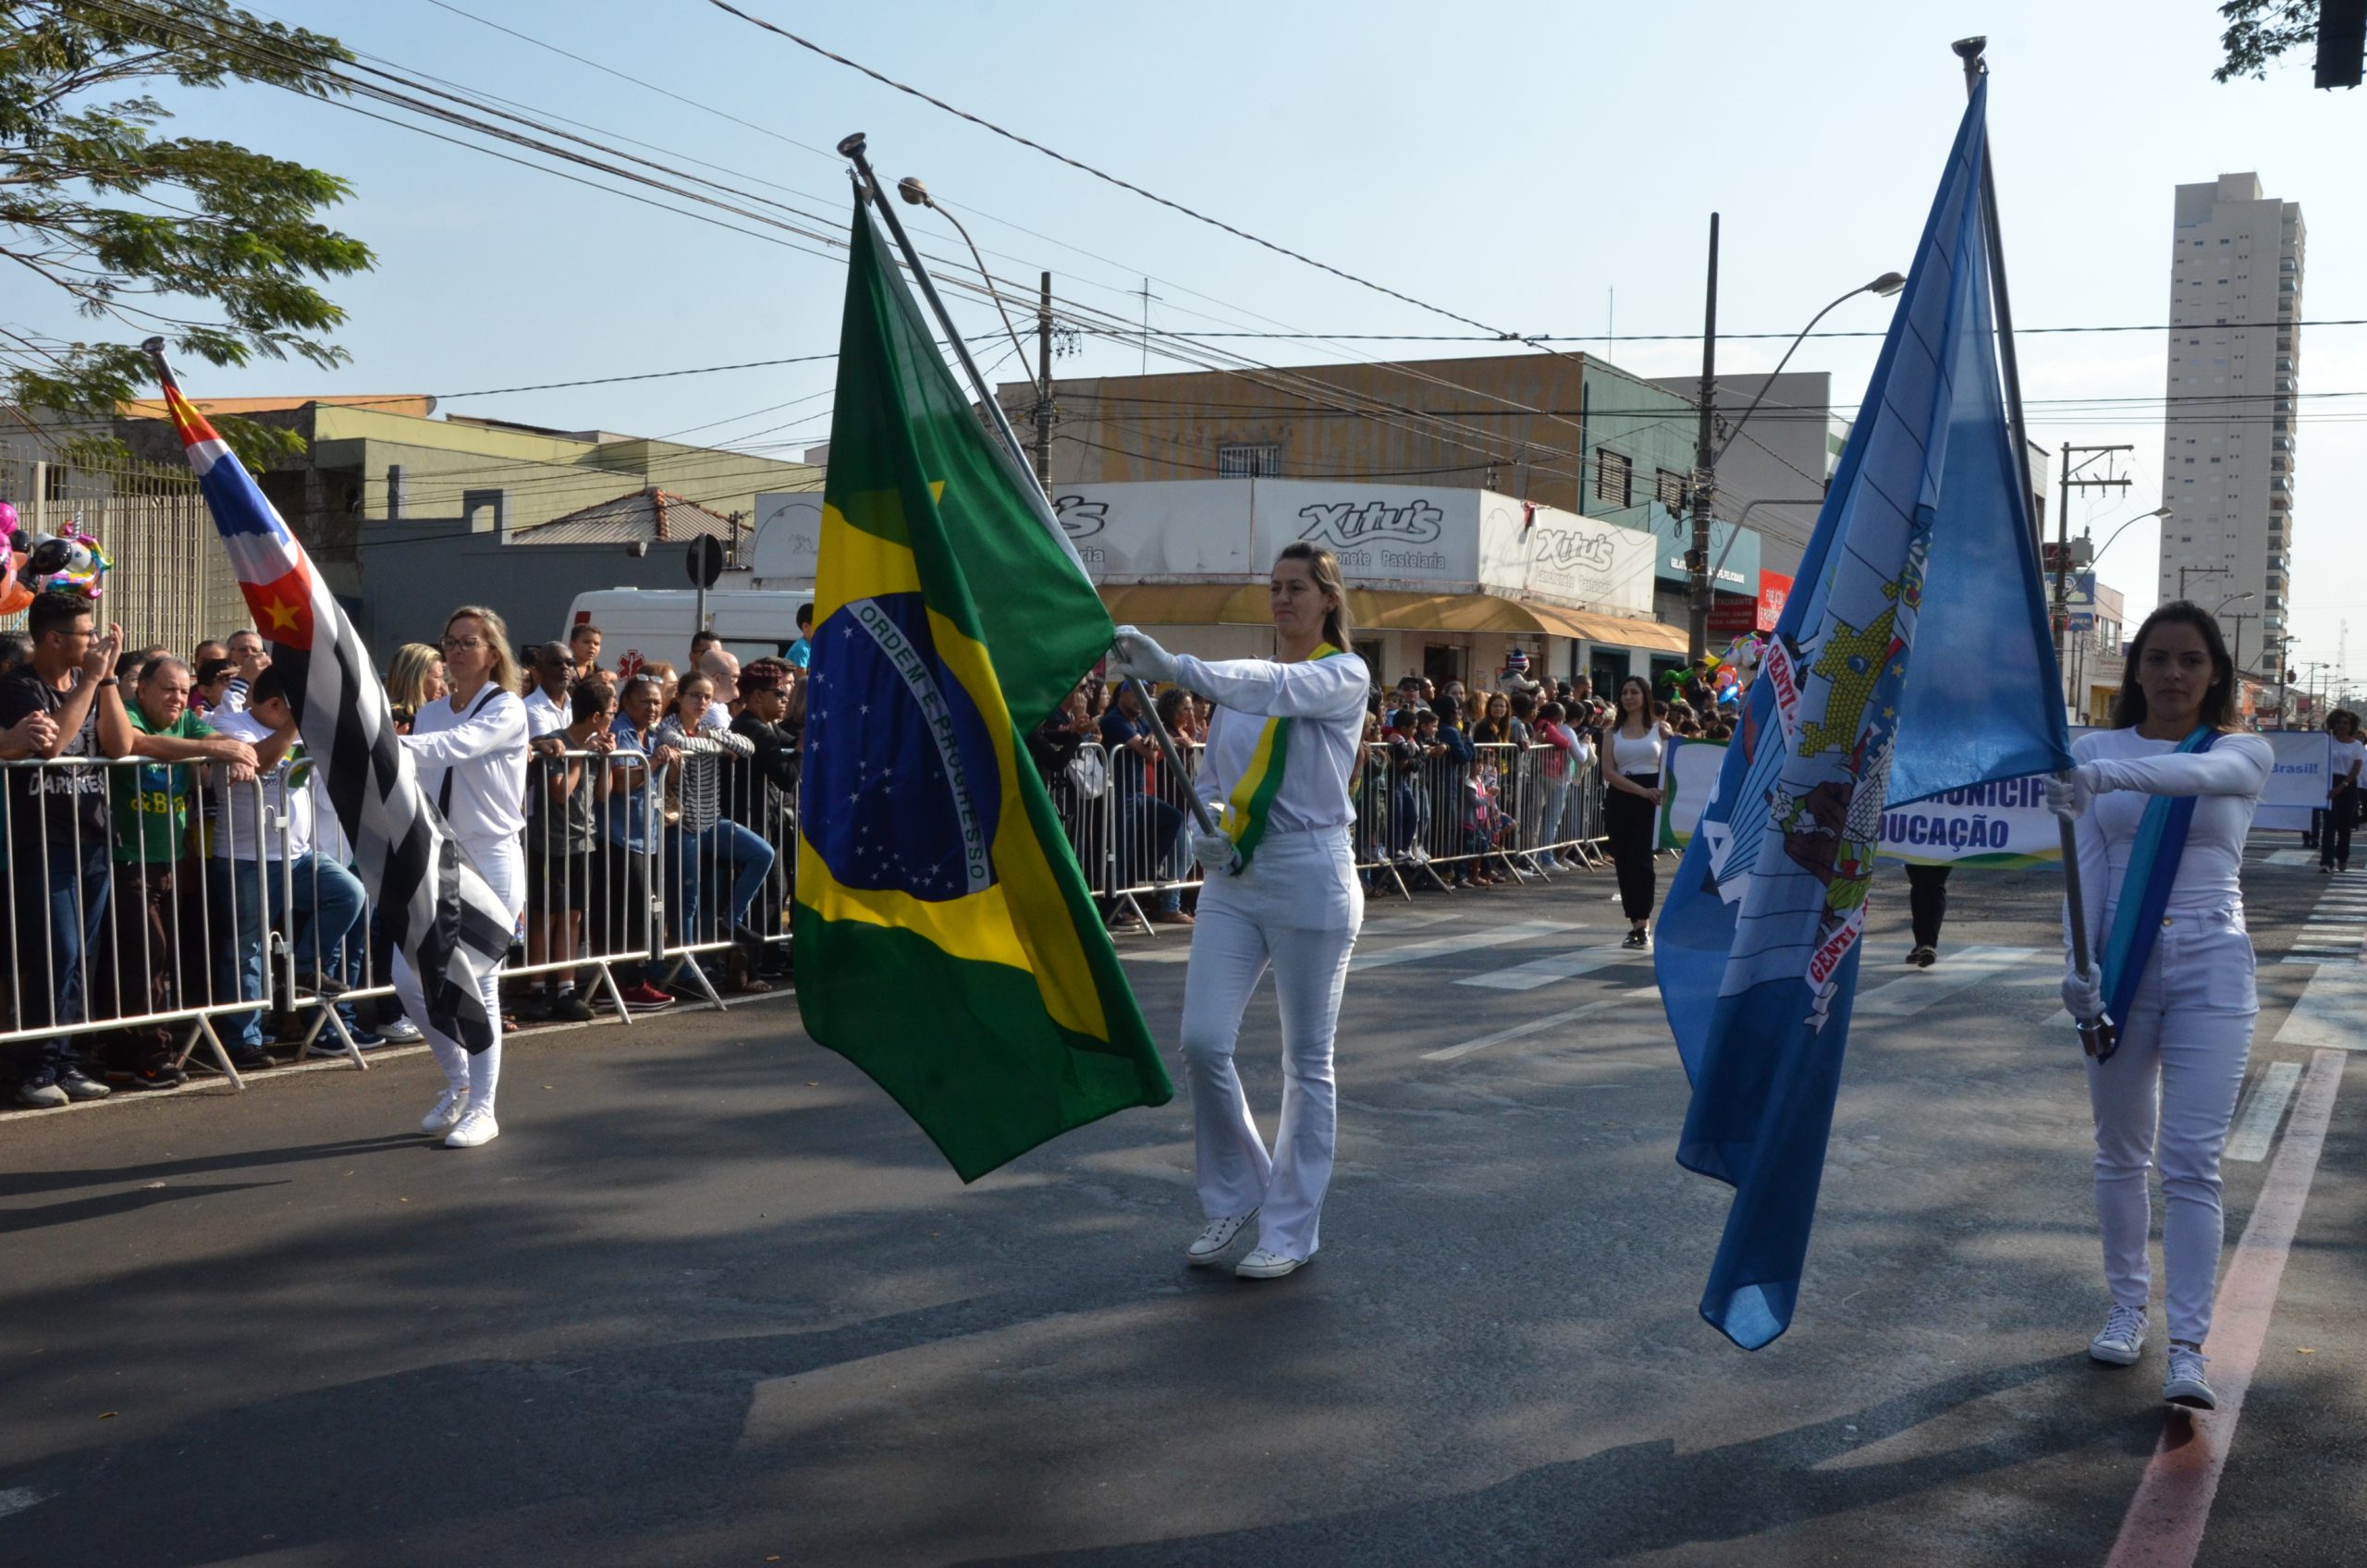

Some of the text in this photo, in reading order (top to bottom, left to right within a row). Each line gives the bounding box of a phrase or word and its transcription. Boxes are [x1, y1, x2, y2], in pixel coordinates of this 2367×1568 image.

[1381, 550, 1446, 570] Pastelaria
[1767, 643, 1797, 711] GENTI
[860, 606, 986, 879] ORDEM E PROGRESSO
[1809, 925, 1858, 985] GENTI
